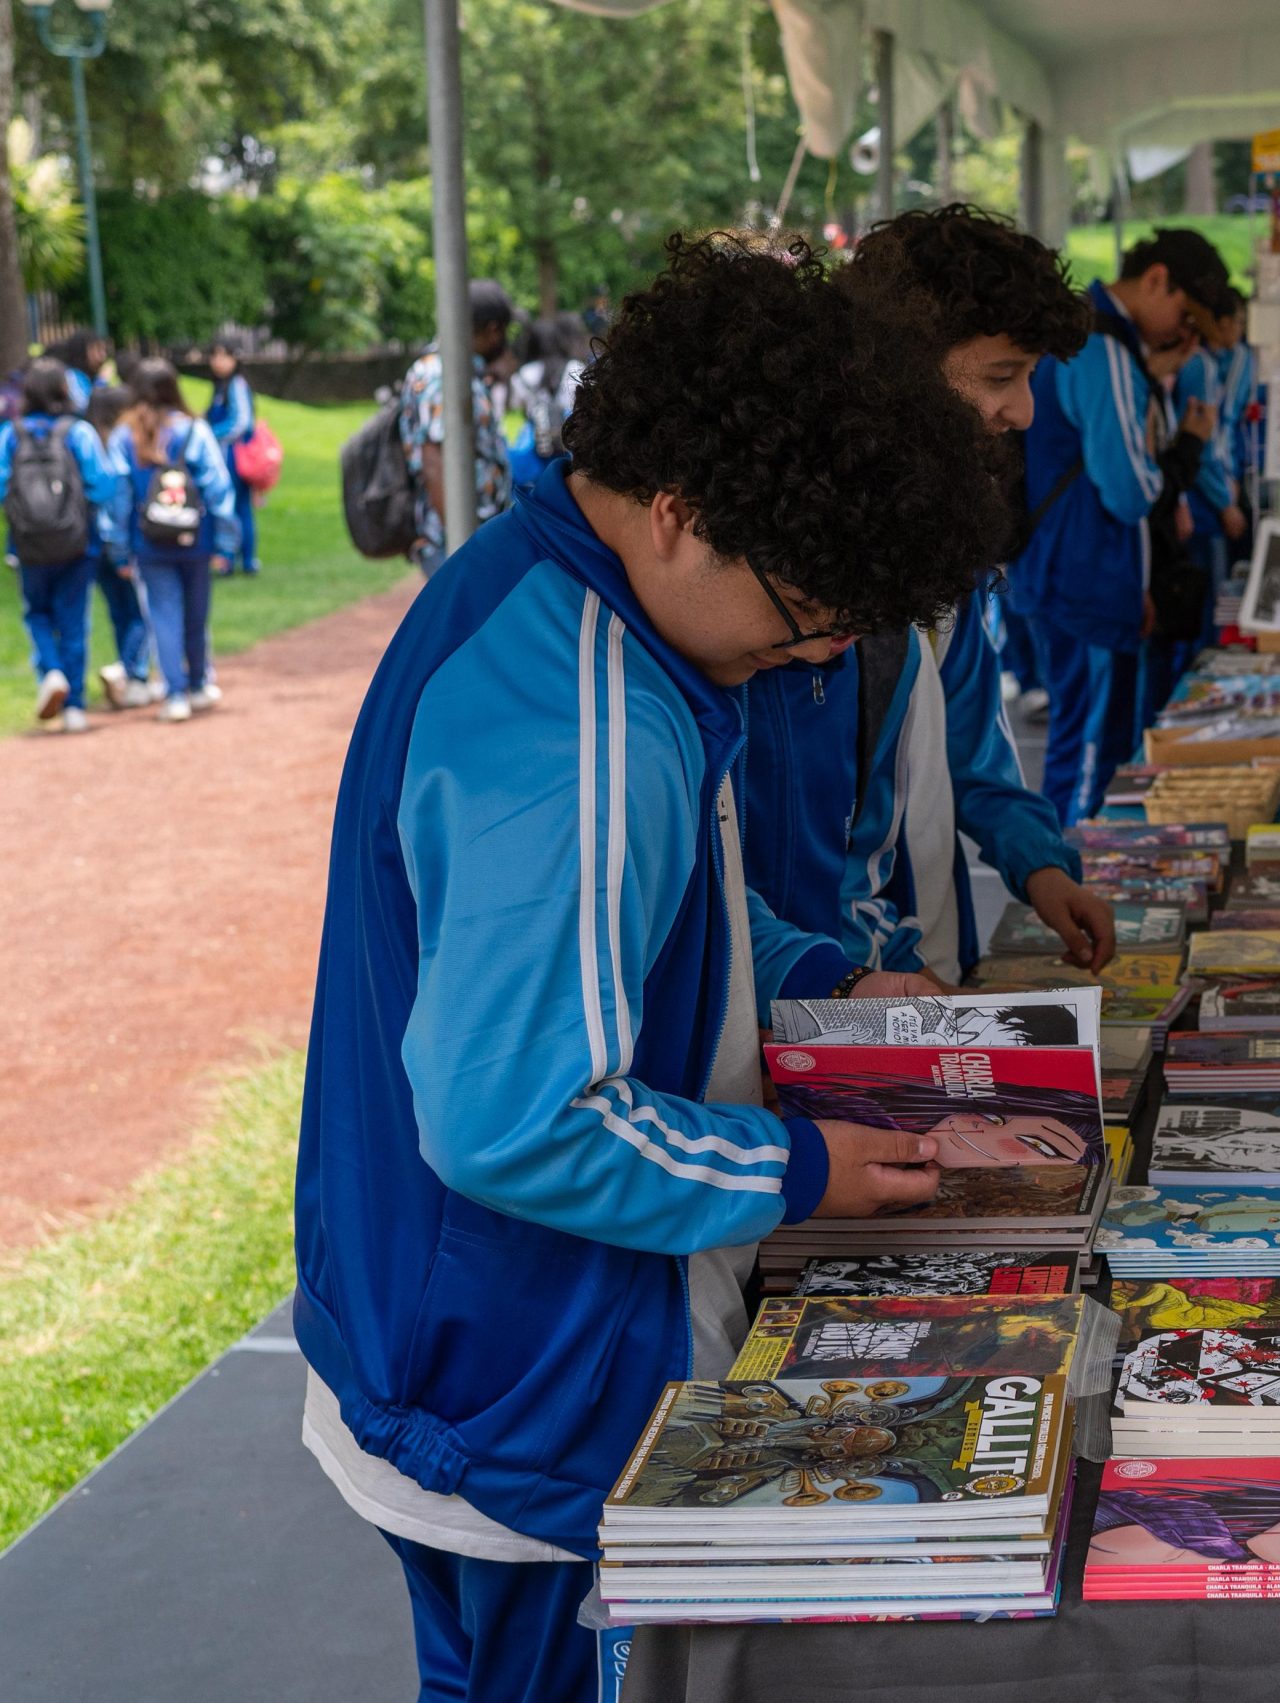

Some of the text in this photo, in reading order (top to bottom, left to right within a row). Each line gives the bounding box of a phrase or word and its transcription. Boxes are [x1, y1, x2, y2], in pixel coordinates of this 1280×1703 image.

[901, 1019, 909, 1033] SER
[938, 1052, 967, 1098] TRANQUILA
[960, 1052, 997, 1098] CHARLA
[811, 1322, 877, 1360] ROTOS
[864, 1322, 920, 1359] SUEÑOS
